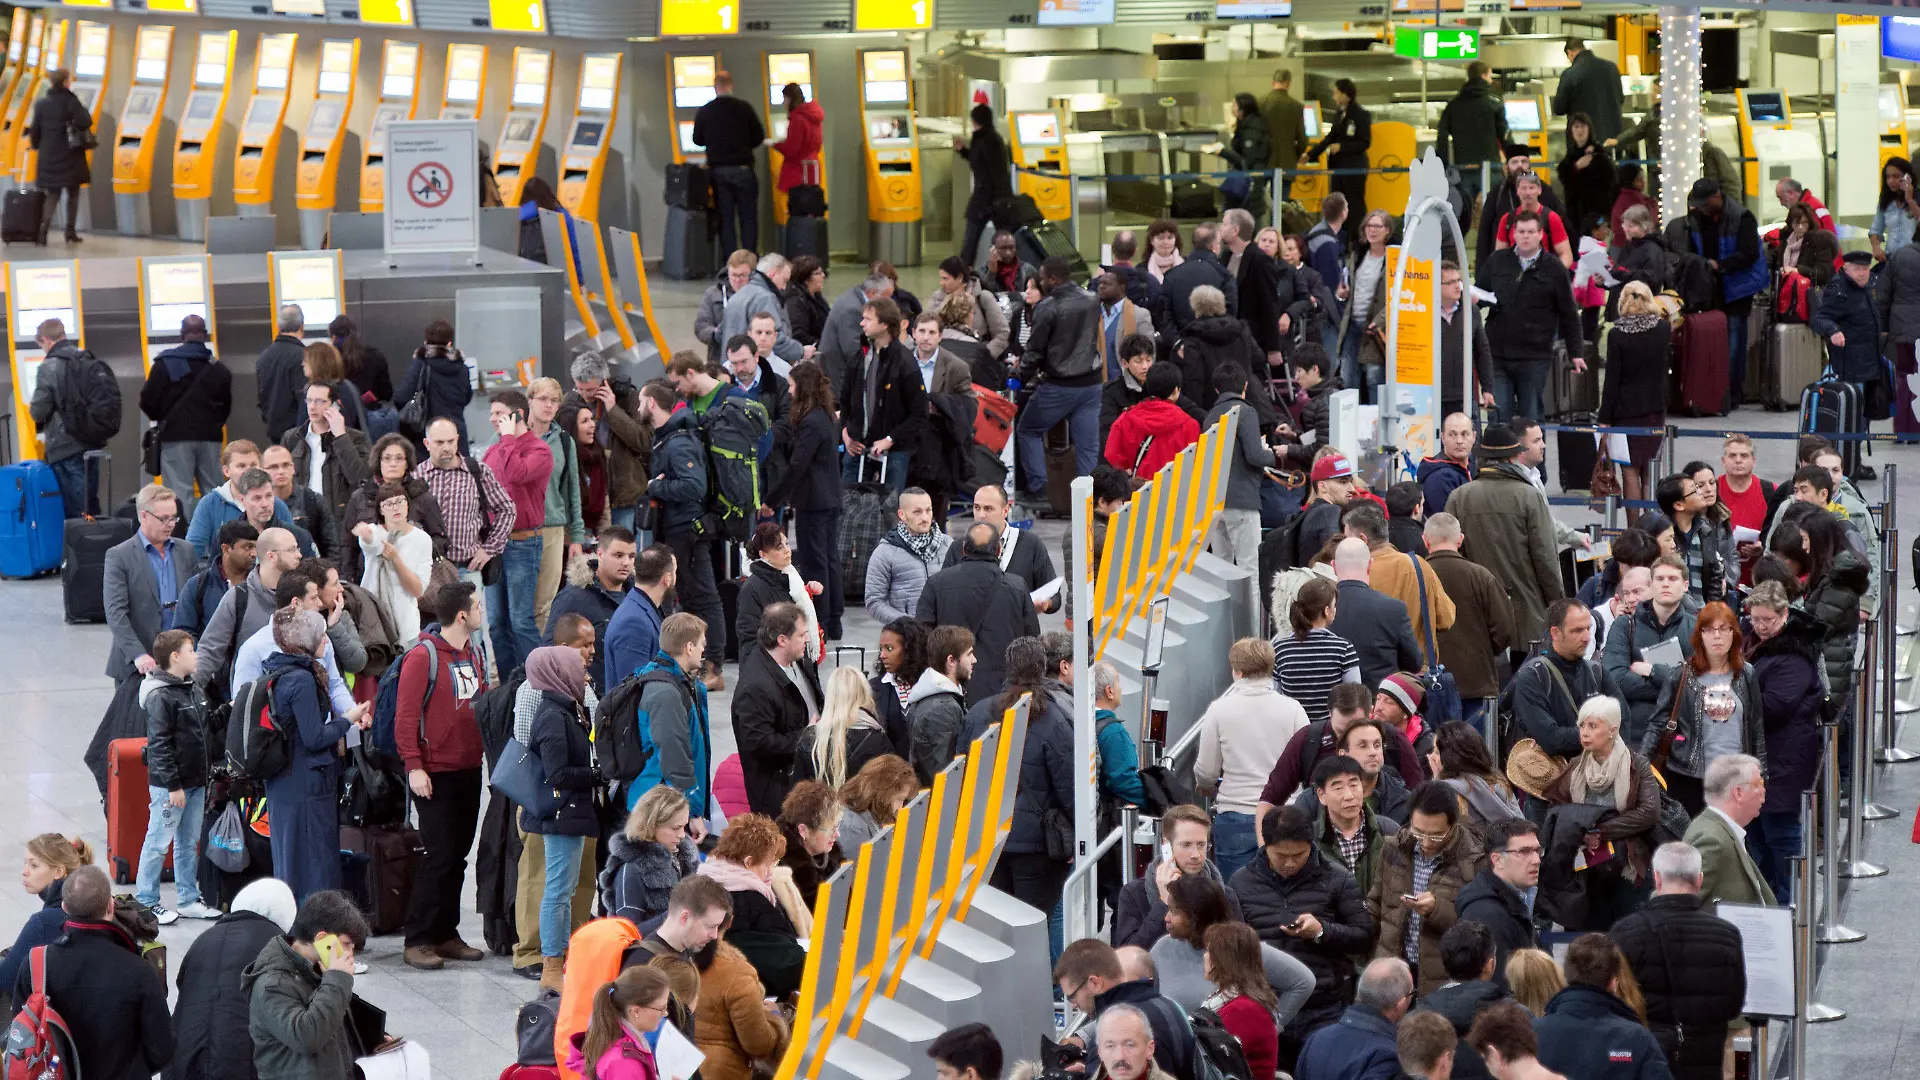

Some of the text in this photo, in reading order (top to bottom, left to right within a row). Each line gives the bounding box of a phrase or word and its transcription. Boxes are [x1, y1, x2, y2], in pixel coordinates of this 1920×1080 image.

[527, 3, 541, 29] 1
[717, 5, 732, 30] 1
[911, 0, 926, 25] 1
